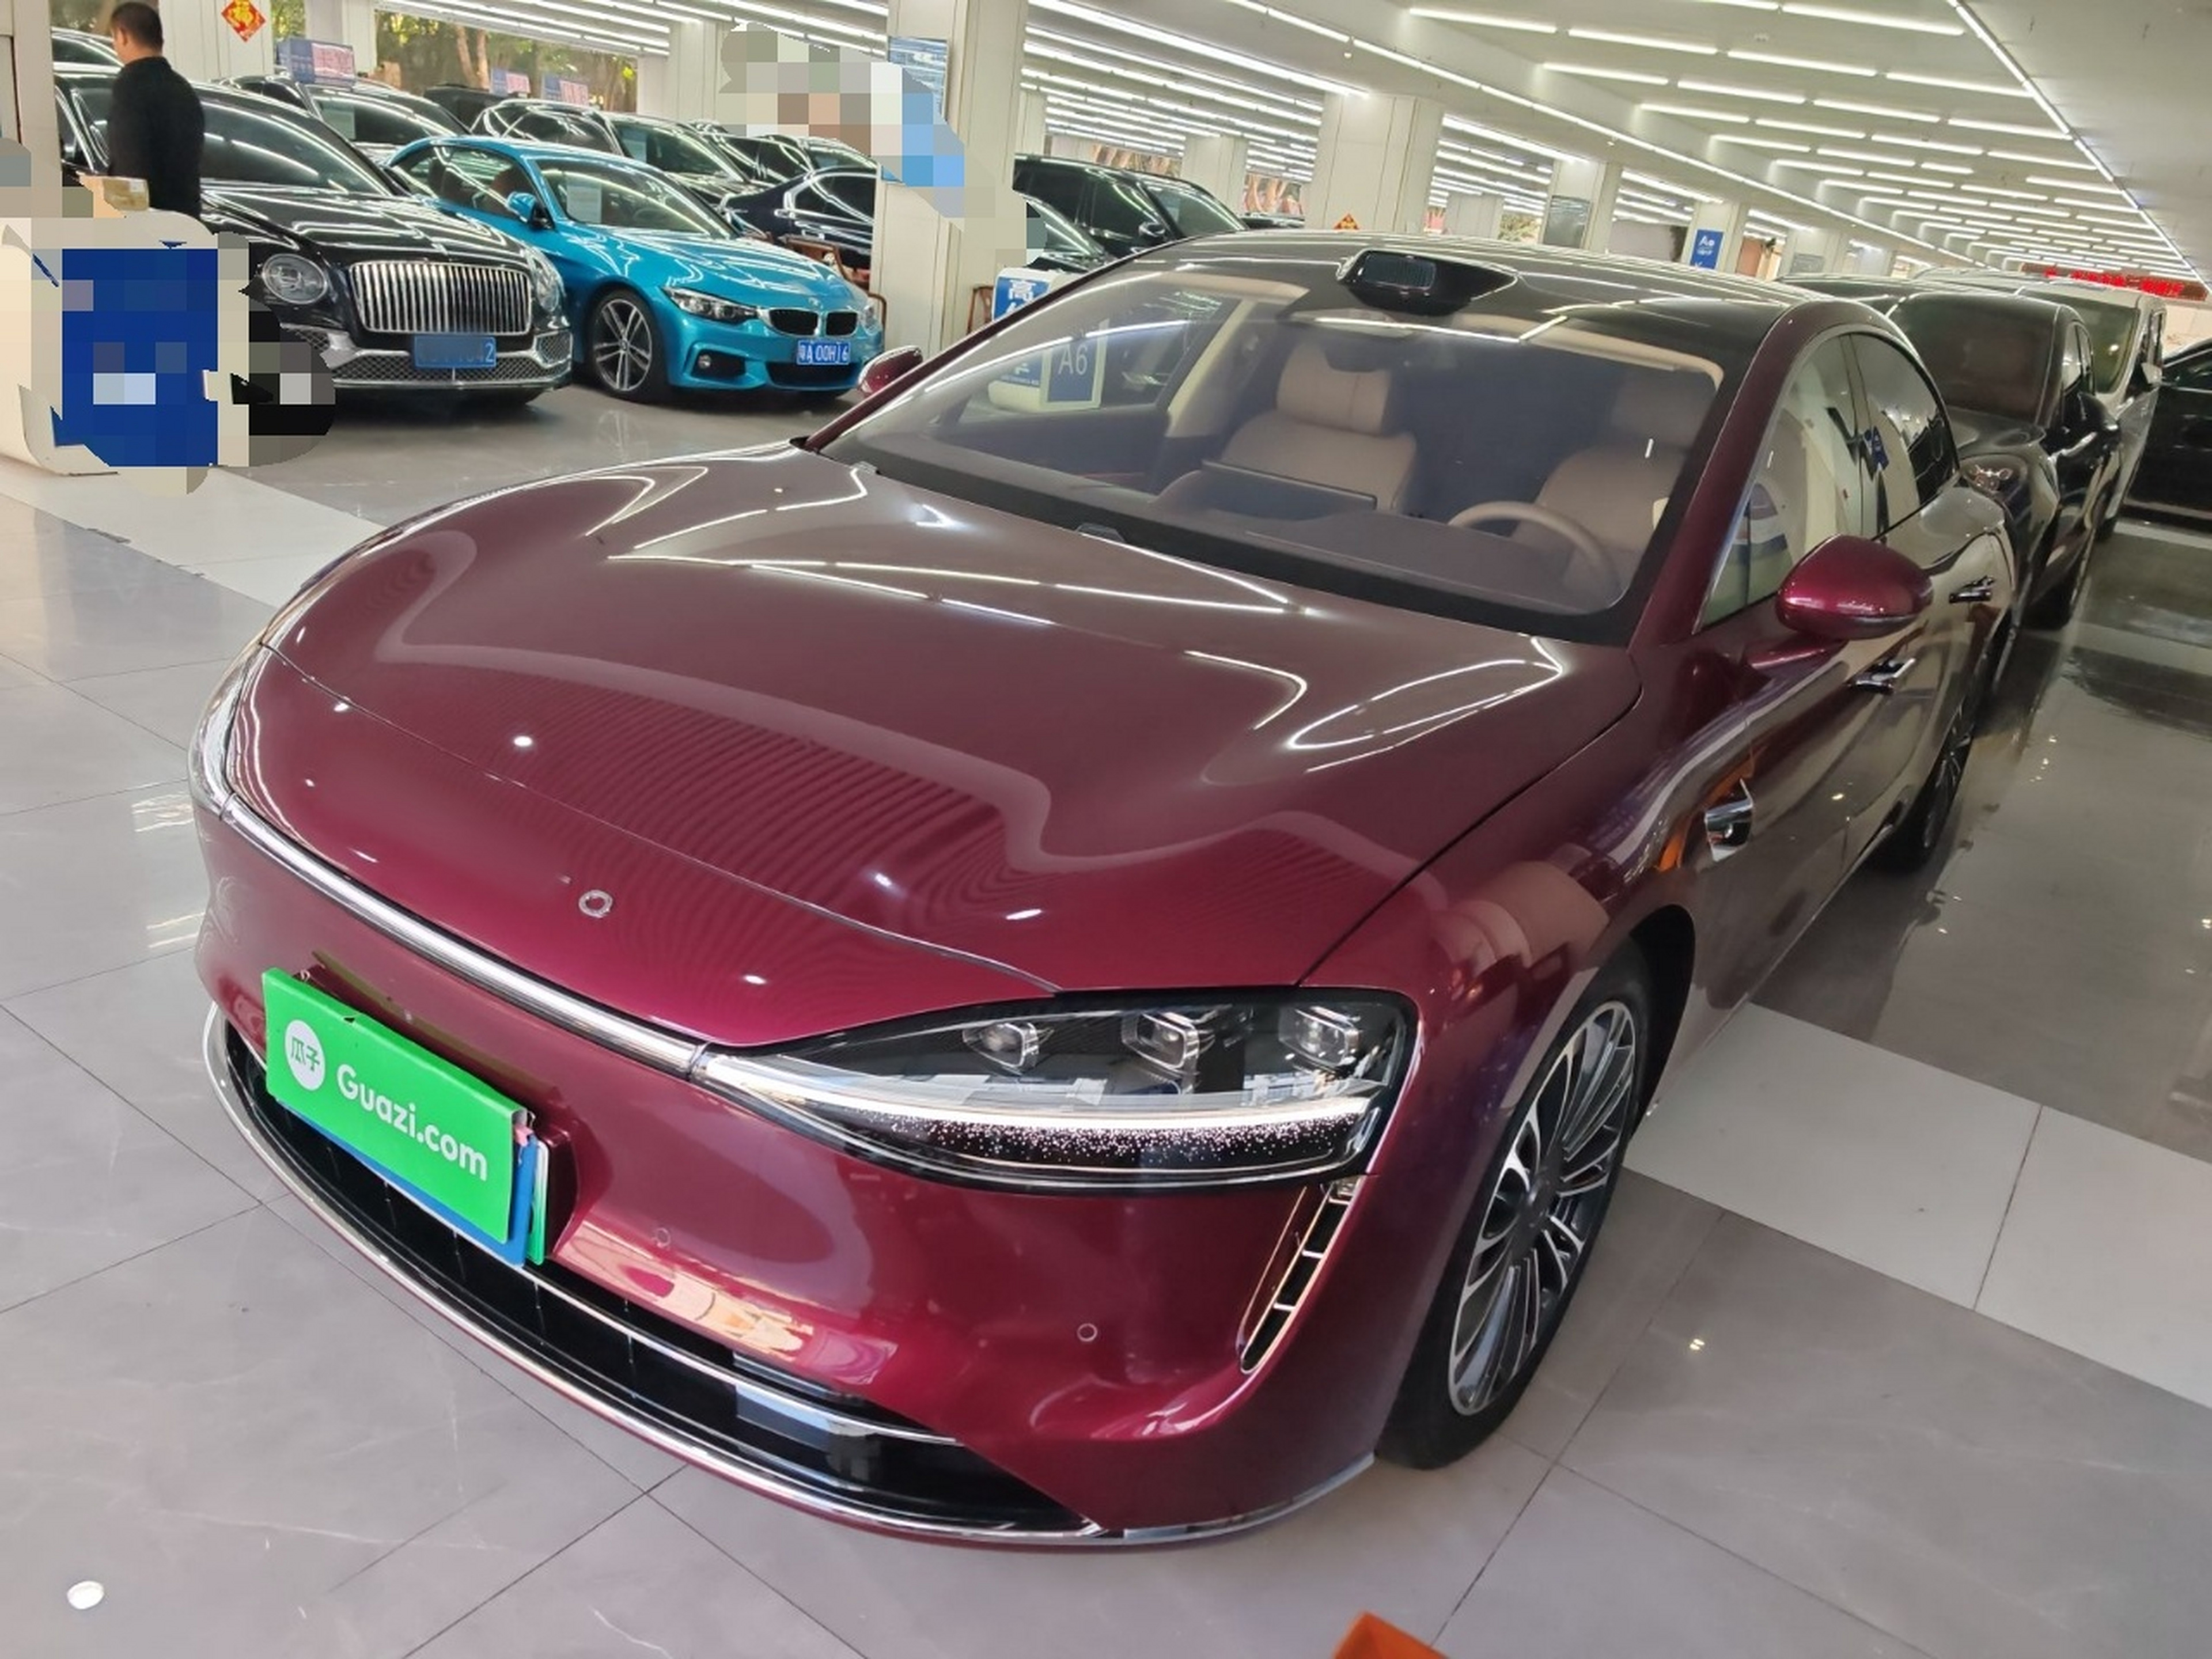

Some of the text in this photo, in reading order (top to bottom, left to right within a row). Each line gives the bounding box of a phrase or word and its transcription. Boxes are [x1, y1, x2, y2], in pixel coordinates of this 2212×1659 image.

[1058, 343, 1088, 375] A6
[291, 1036, 320, 1073] 瓜子
[336, 1063, 487, 1181] Guazi.com
